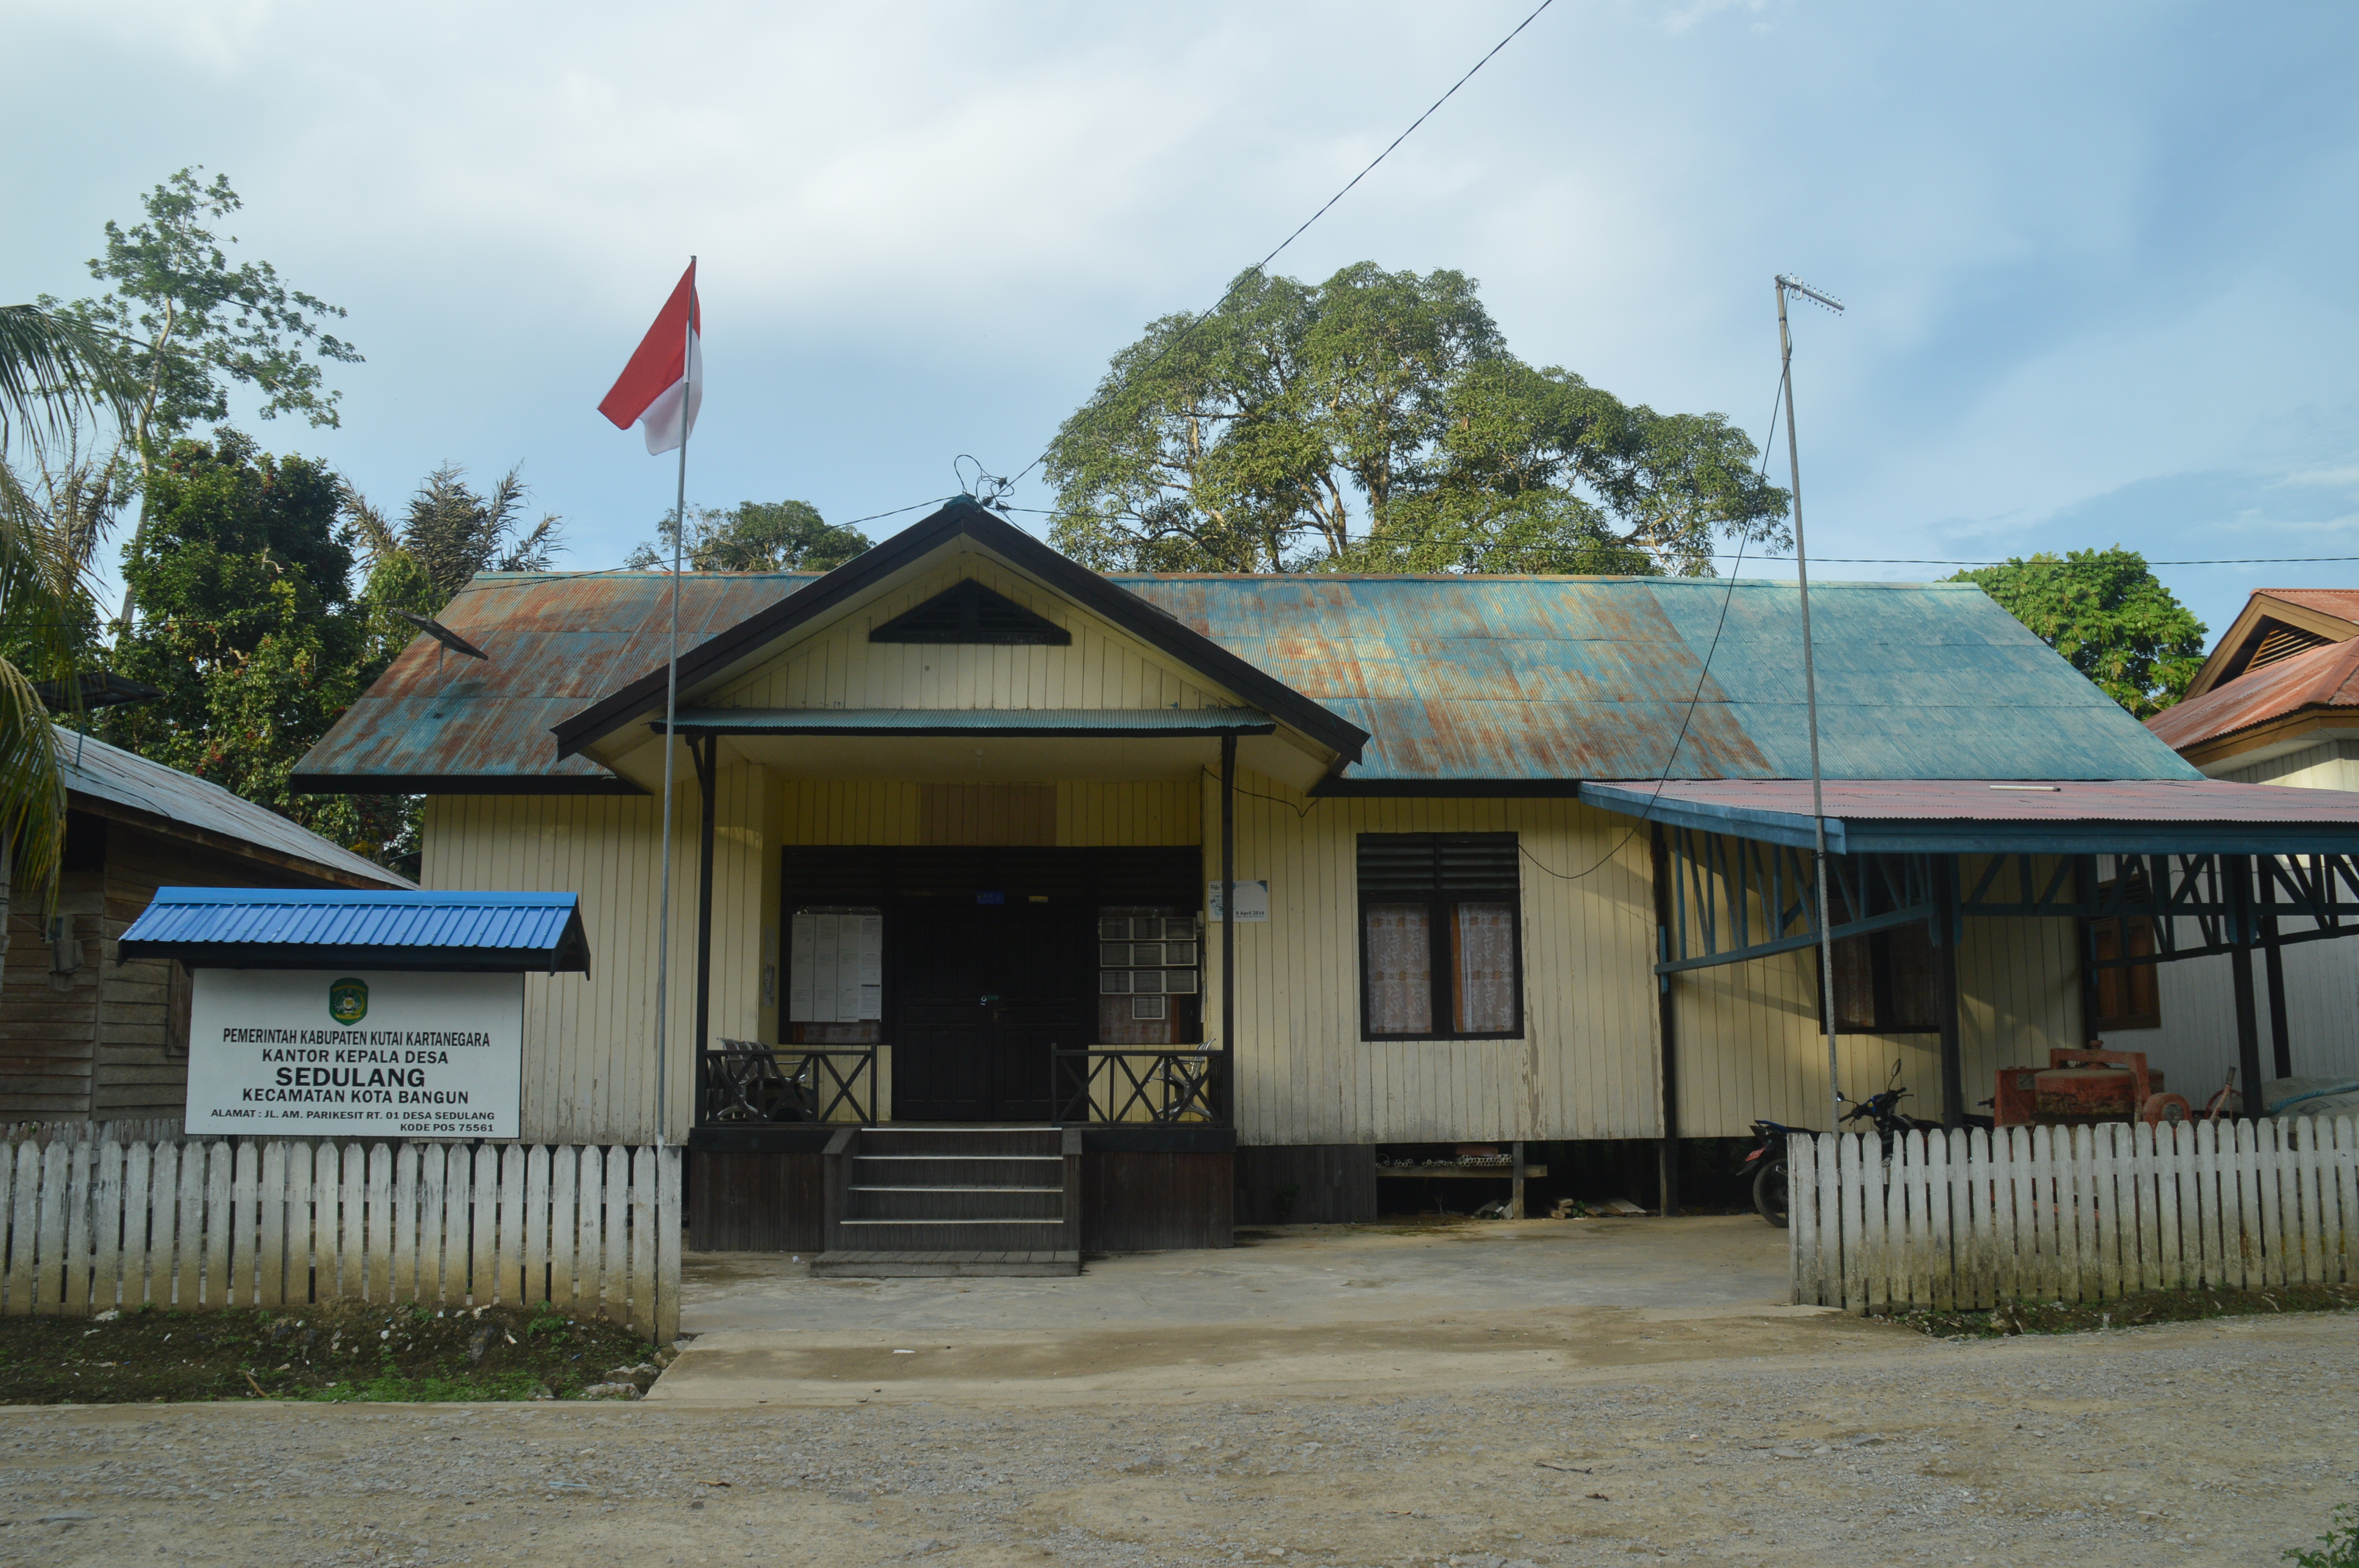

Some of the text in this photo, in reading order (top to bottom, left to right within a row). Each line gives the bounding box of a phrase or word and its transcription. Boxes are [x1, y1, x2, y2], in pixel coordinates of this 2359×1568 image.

[223, 1028, 489, 1046] PEMERINTAH KABUPATEN KUTAI KARTANEGARA
[262, 1049, 448, 1064] KANTOR KEPALA DESA
[276, 1067, 425, 1087] SEDULANG
[243, 1088, 468, 1104] KECAMATAN KOTA BANGUN
